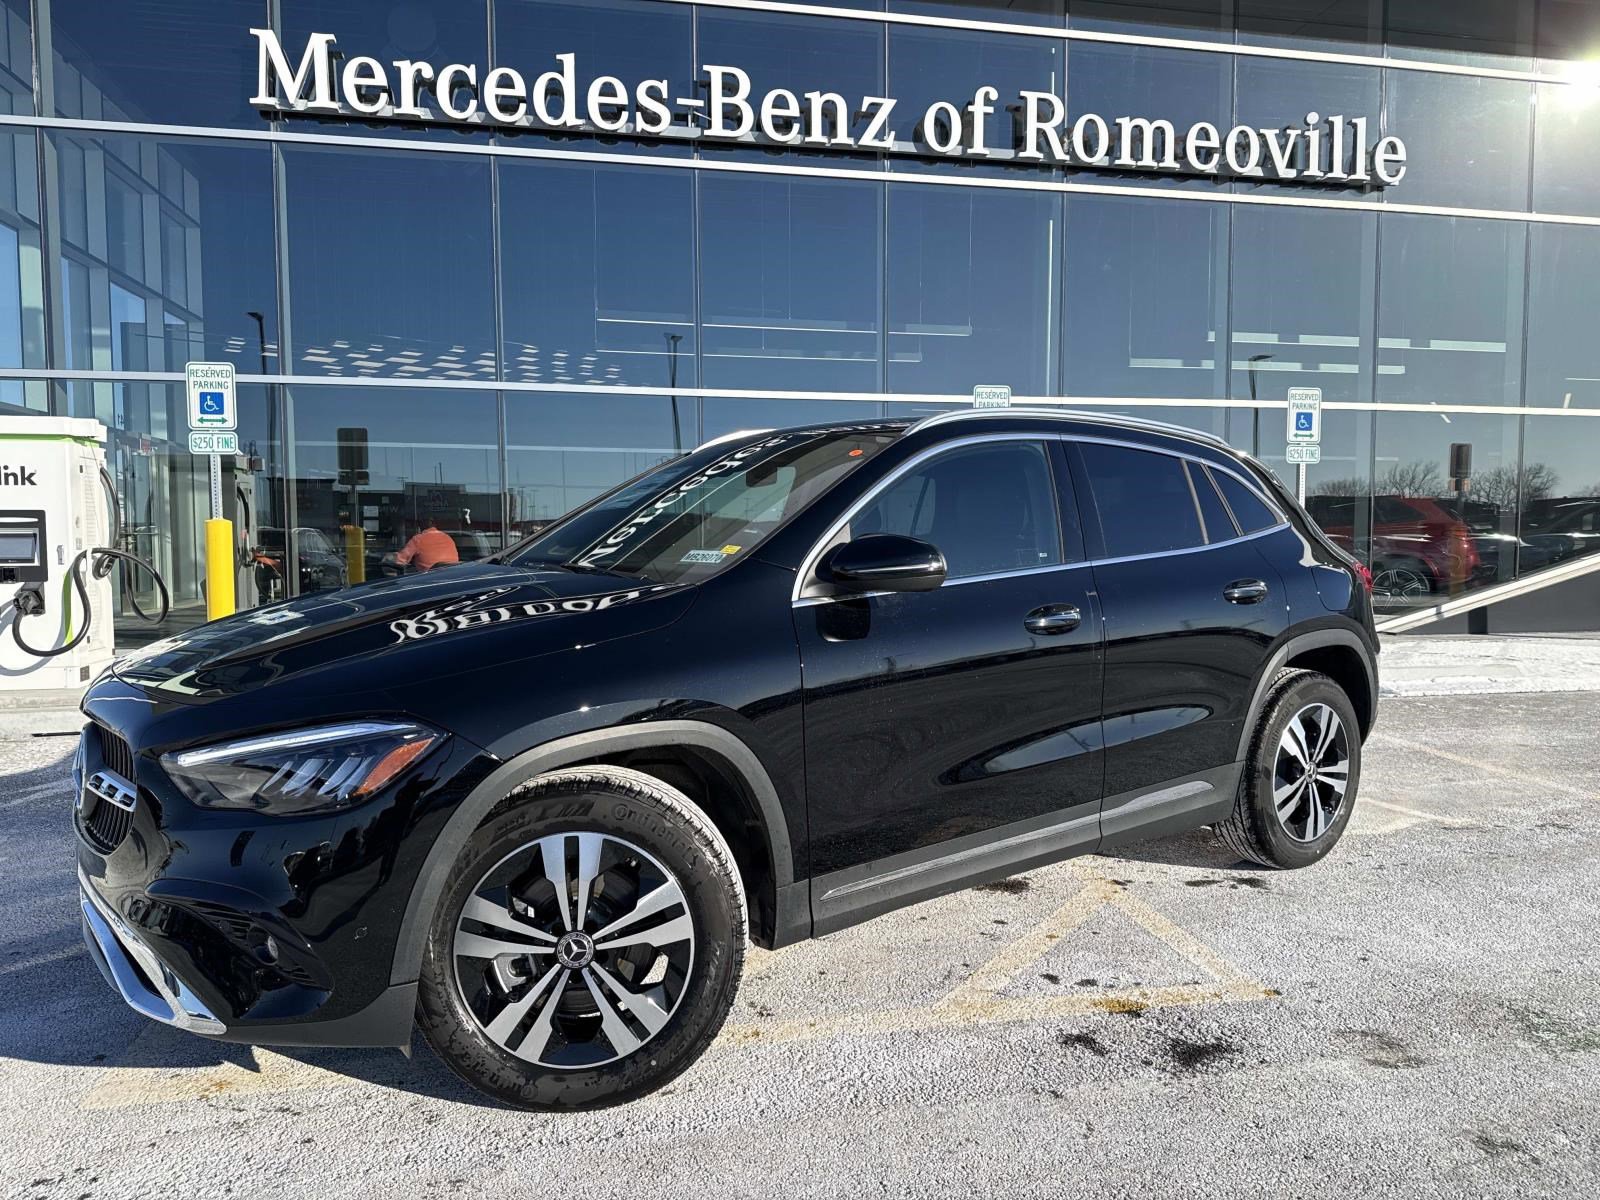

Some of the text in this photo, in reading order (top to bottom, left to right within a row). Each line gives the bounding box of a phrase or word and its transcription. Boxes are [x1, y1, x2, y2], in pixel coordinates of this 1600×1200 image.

[250, 28, 1407, 186] Mercedes-Benz of Romeoville
[190, 369, 231, 378] RESERVED
[193, 380, 229, 390] PARKING
[976, 391, 1008, 400] RESERVED
[1290, 392, 1319, 401] RESERVED
[1292, 402, 1317, 411] PARKING
[192, 436, 235, 449] $250 FINE
[1289, 448, 1318, 460] $250 FINE
